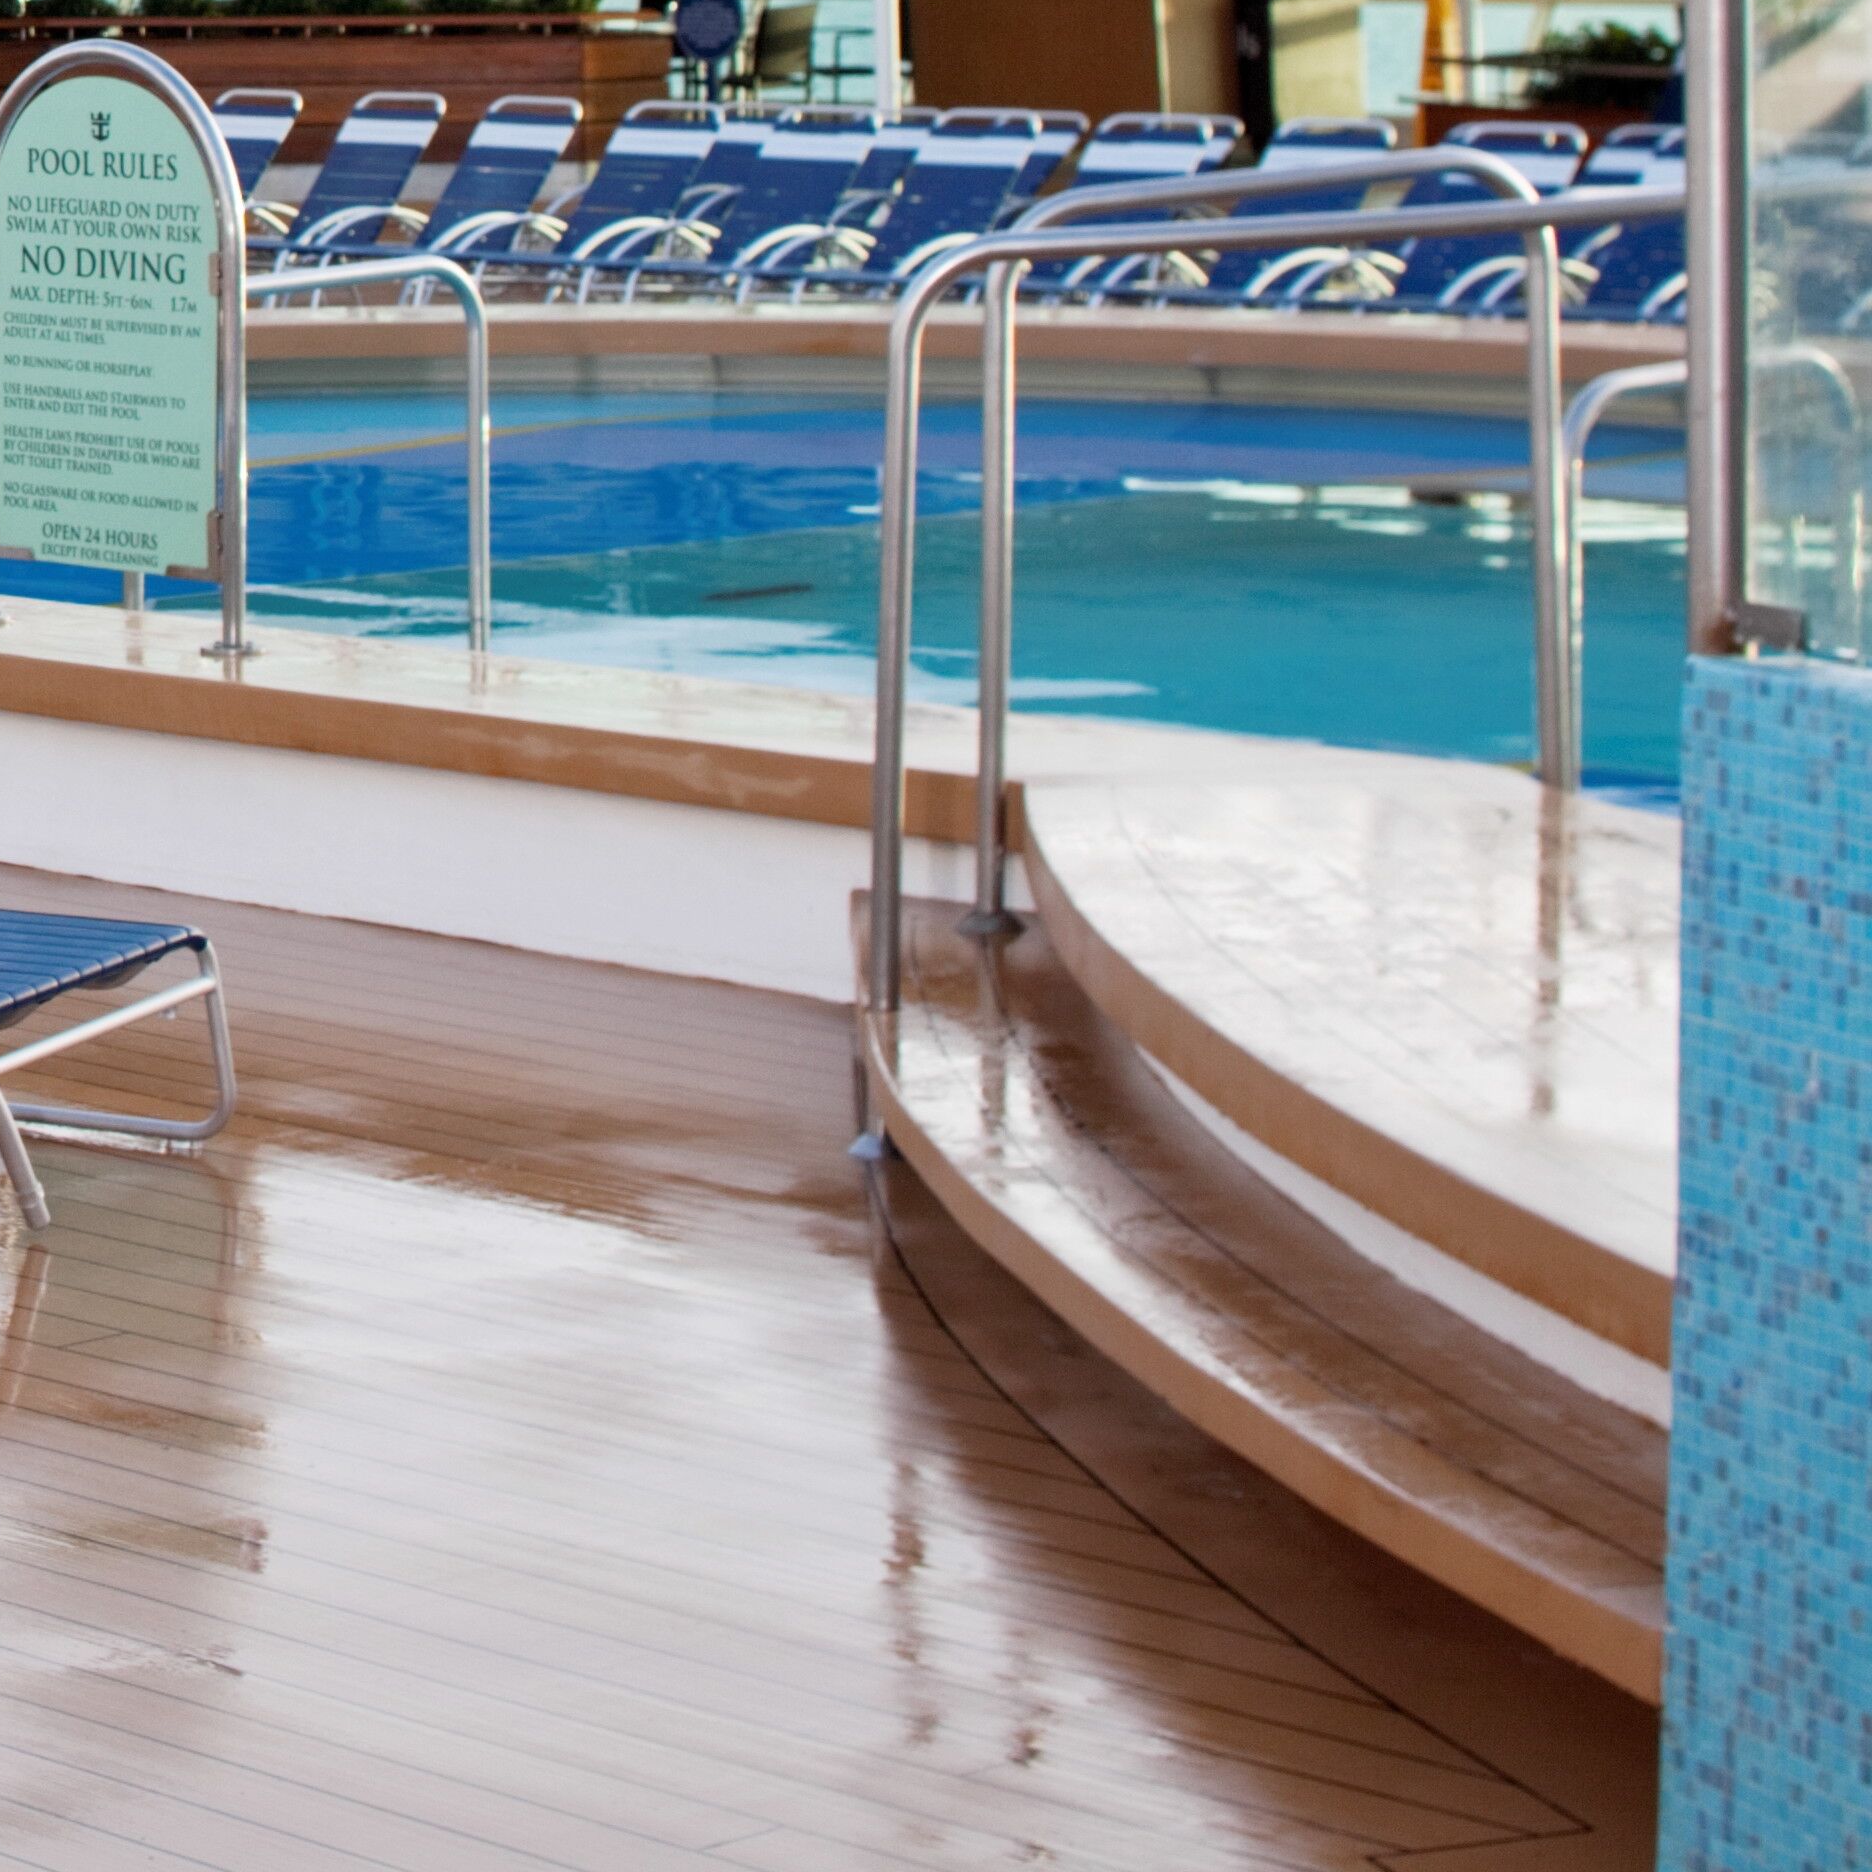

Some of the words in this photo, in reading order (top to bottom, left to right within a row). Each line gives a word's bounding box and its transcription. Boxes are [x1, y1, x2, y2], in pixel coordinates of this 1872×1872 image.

[28, 148, 94, 176] POOL
[104, 151, 178, 181] RULES
[8, 195, 31, 211] NO
[36, 196, 121, 217] LIFEGUARD
[125, 202, 150, 219] ON
[156, 204, 200, 222] DUTY
[7, 215, 47, 234] SWIM
[50, 219, 70, 235] AT
[73, 220, 120, 238] YOUR
[121, 223, 160, 240] OWN
[166, 226, 202, 243] RISK
[21, 244, 65, 275] NO
[76, 248, 186, 284] DIVING
[48, 287, 99, 306] DEPTH:
[3, 326, 36, 339] ADULT
[39, 328, 51, 340] AT
[55, 330, 71, 342] ALL
[4, 311, 56, 327] CHILDREN
[61, 316, 87, 328] MUST
[91, 318, 102, 330] BE
[106, 319, 168, 336] SUPERVISED
[171, 325, 183, 336] BY
[186, 325, 201, 337] AN
[4, 355, 20, 366] NO
[23, 356, 73, 372] RUNNING
[75, 361, 91, 372] OR
[4, 382, 21, 394] USE
[24, 383, 82, 400] HANDRAILS
[85, 389, 106, 402] AND
[110, 391, 168, 408] STAIRWAYS
[170, 398, 186, 410] TO
[4, 396, 36, 410] ENTER
[38, 399, 60, 411] AND
[63, 402, 85, 415] EXIT
[88, 404, 108, 416] THE
[4, 424, 43, 439] HEALTH
[46, 429, 72, 442] LAWS
[74, 431, 124, 447] PROHIBIT
[127, 438, 144, 449] USE
[148, 440, 162, 451] OF
[166, 441, 200, 454] POOLS
[4, 438, 14, 450] BY
[17, 440, 70, 455] CHILDREN
[73, 446, 86, 456] IN
[88, 447, 130, 462] DIAPERS
[133, 451, 148, 463] OR
[151, 454, 179, 467] WHO
[182, 457, 200, 469] ARE
[4, 453, 25, 465] NOT
[28, 455, 62, 470] TOILET
[4, 482, 19, 493] NO
[22, 483, 77, 500] GLASSWARE
[81, 490, 96, 502] OR
[98, 492, 129, 505] FOOD
[132, 495, 183, 511] ALLOWED
[186, 499, 198, 512] IN
[4, 496, 31, 508] POOL
[42, 522, 81, 541] OPEN
[85, 528, 100, 543] 24
[106, 529, 158, 550] HOURS
[42, 543, 77, 558] EXCEPT
[81, 547, 100, 560] FOR
[103, 550, 158, 568] CLEANING
